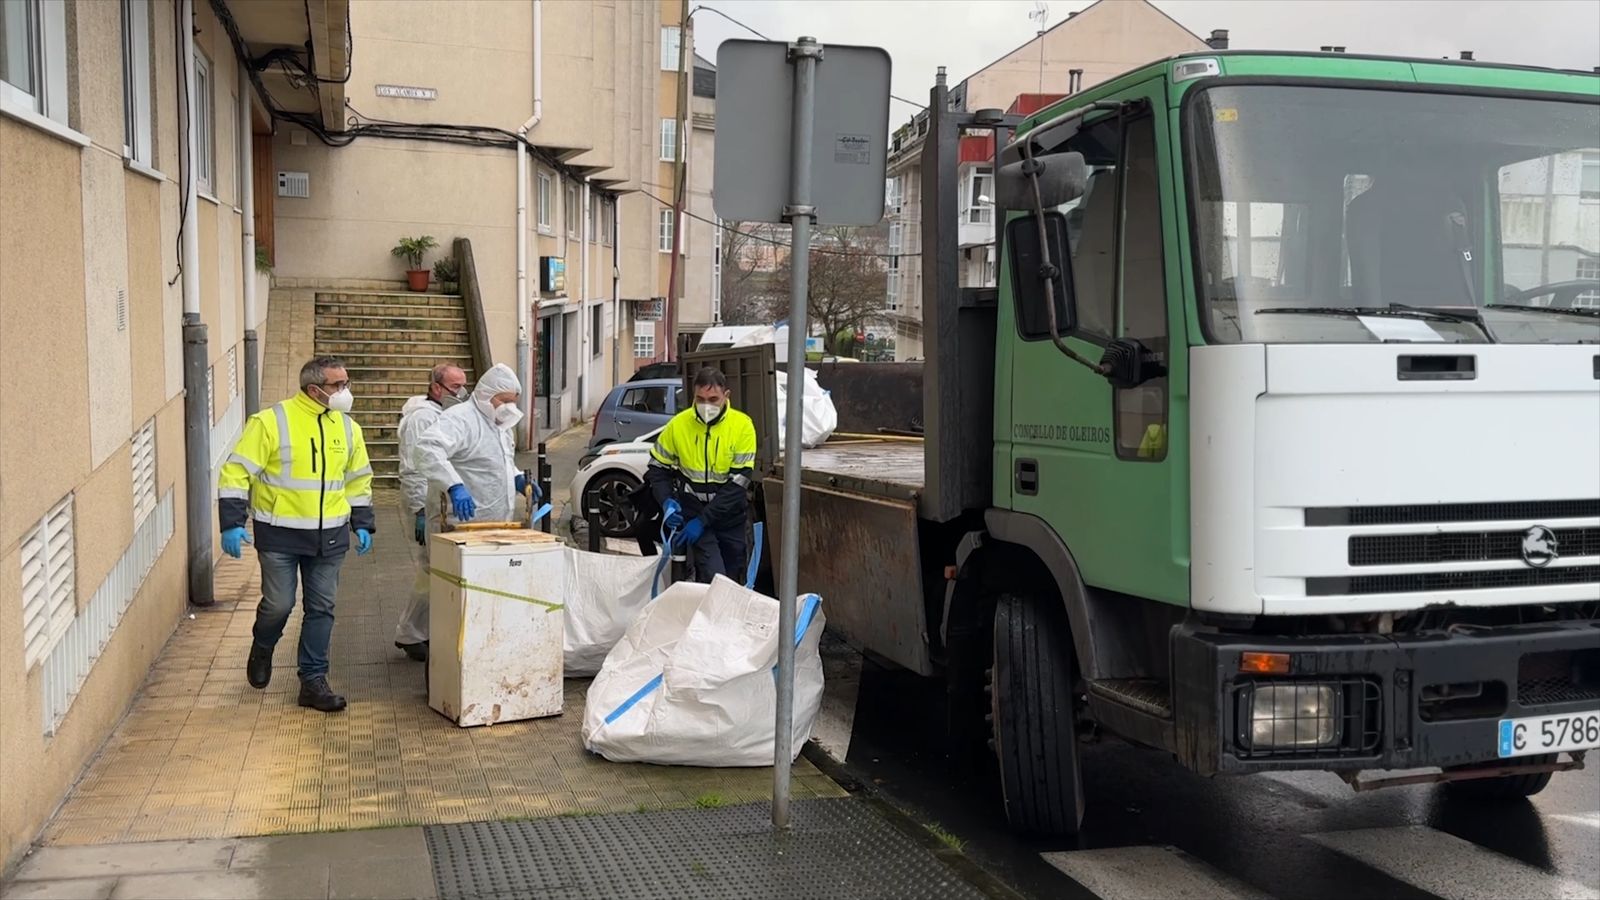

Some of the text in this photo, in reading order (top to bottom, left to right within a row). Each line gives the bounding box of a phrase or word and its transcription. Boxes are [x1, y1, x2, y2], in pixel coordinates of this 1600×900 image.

[1013, 423, 1111, 443] CONCELLO DE OLEIROS
[1503, 715, 1599, 750] E C 5786
